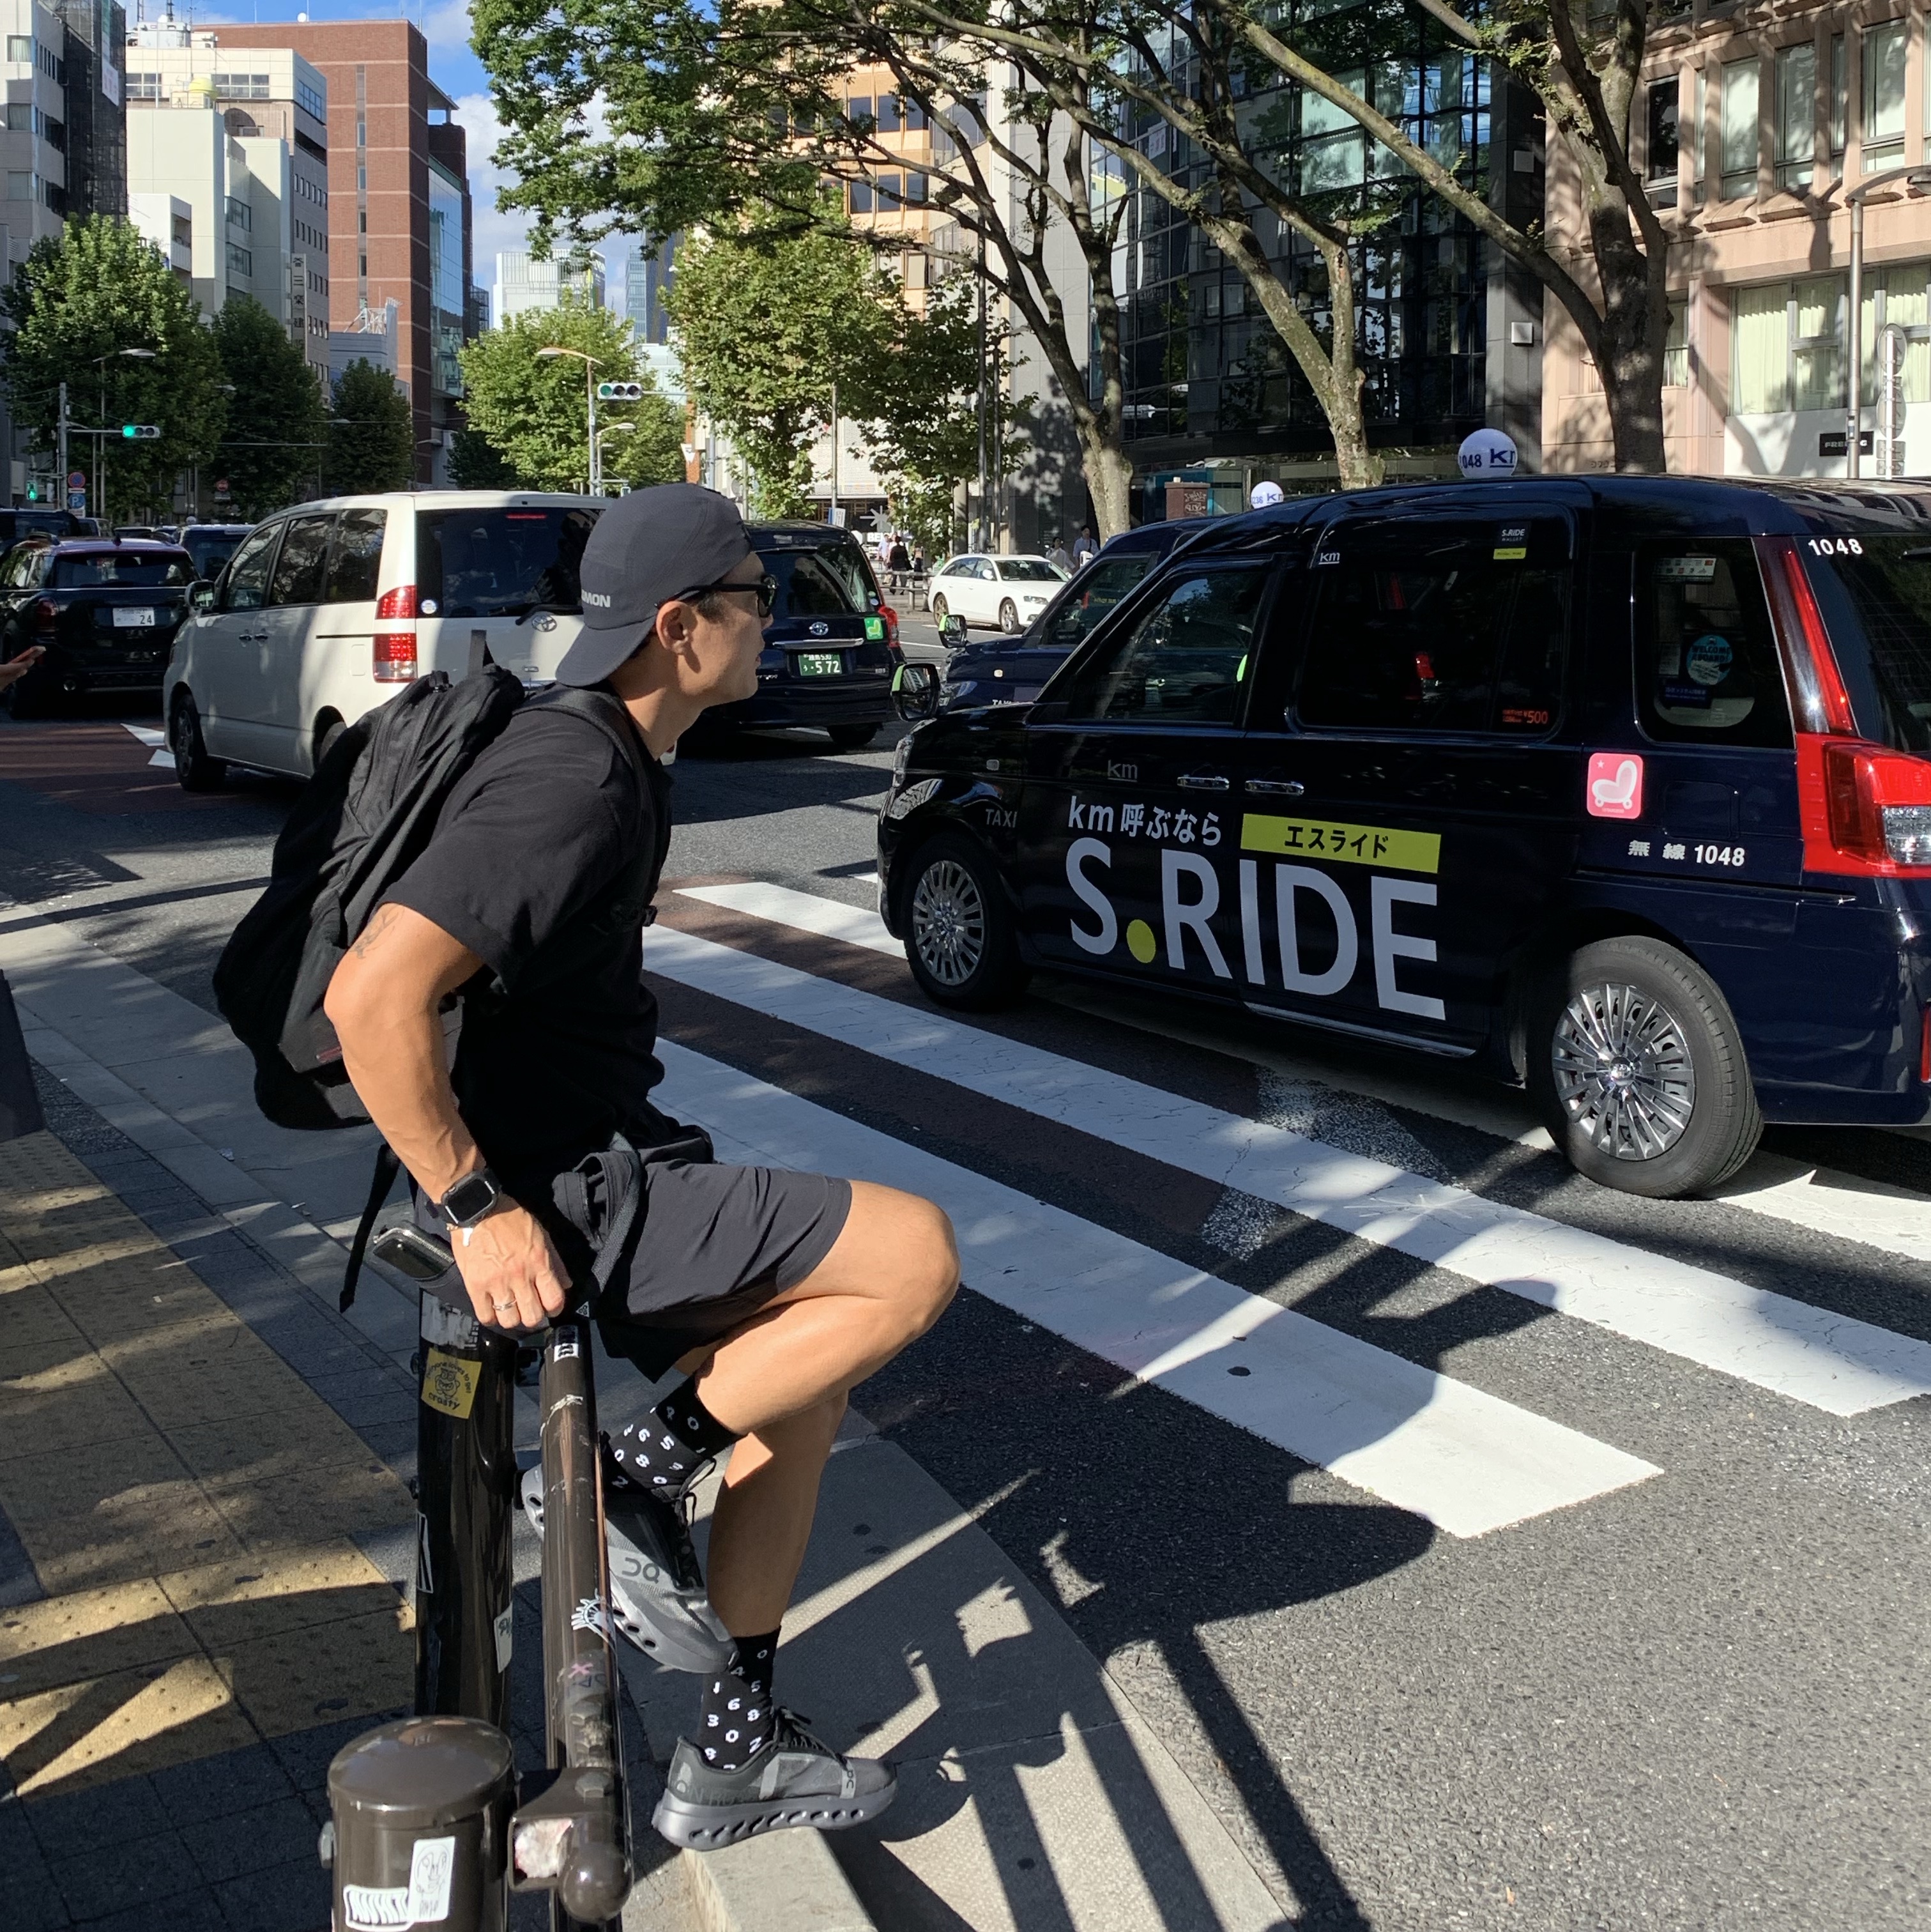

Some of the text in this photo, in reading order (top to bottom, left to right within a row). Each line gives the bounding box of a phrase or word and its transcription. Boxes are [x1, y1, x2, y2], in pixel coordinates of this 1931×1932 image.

[1824, 440, 1868, 448] FREG
[1808, 538, 1863, 556] 1048
[1318, 552, 1340, 565] km
[1108, 760, 1138, 781] km
[985, 808, 1018, 828] TAXI
[1285, 825, 1389, 859] エスライド
[1695, 845, 1745, 867] 1048
